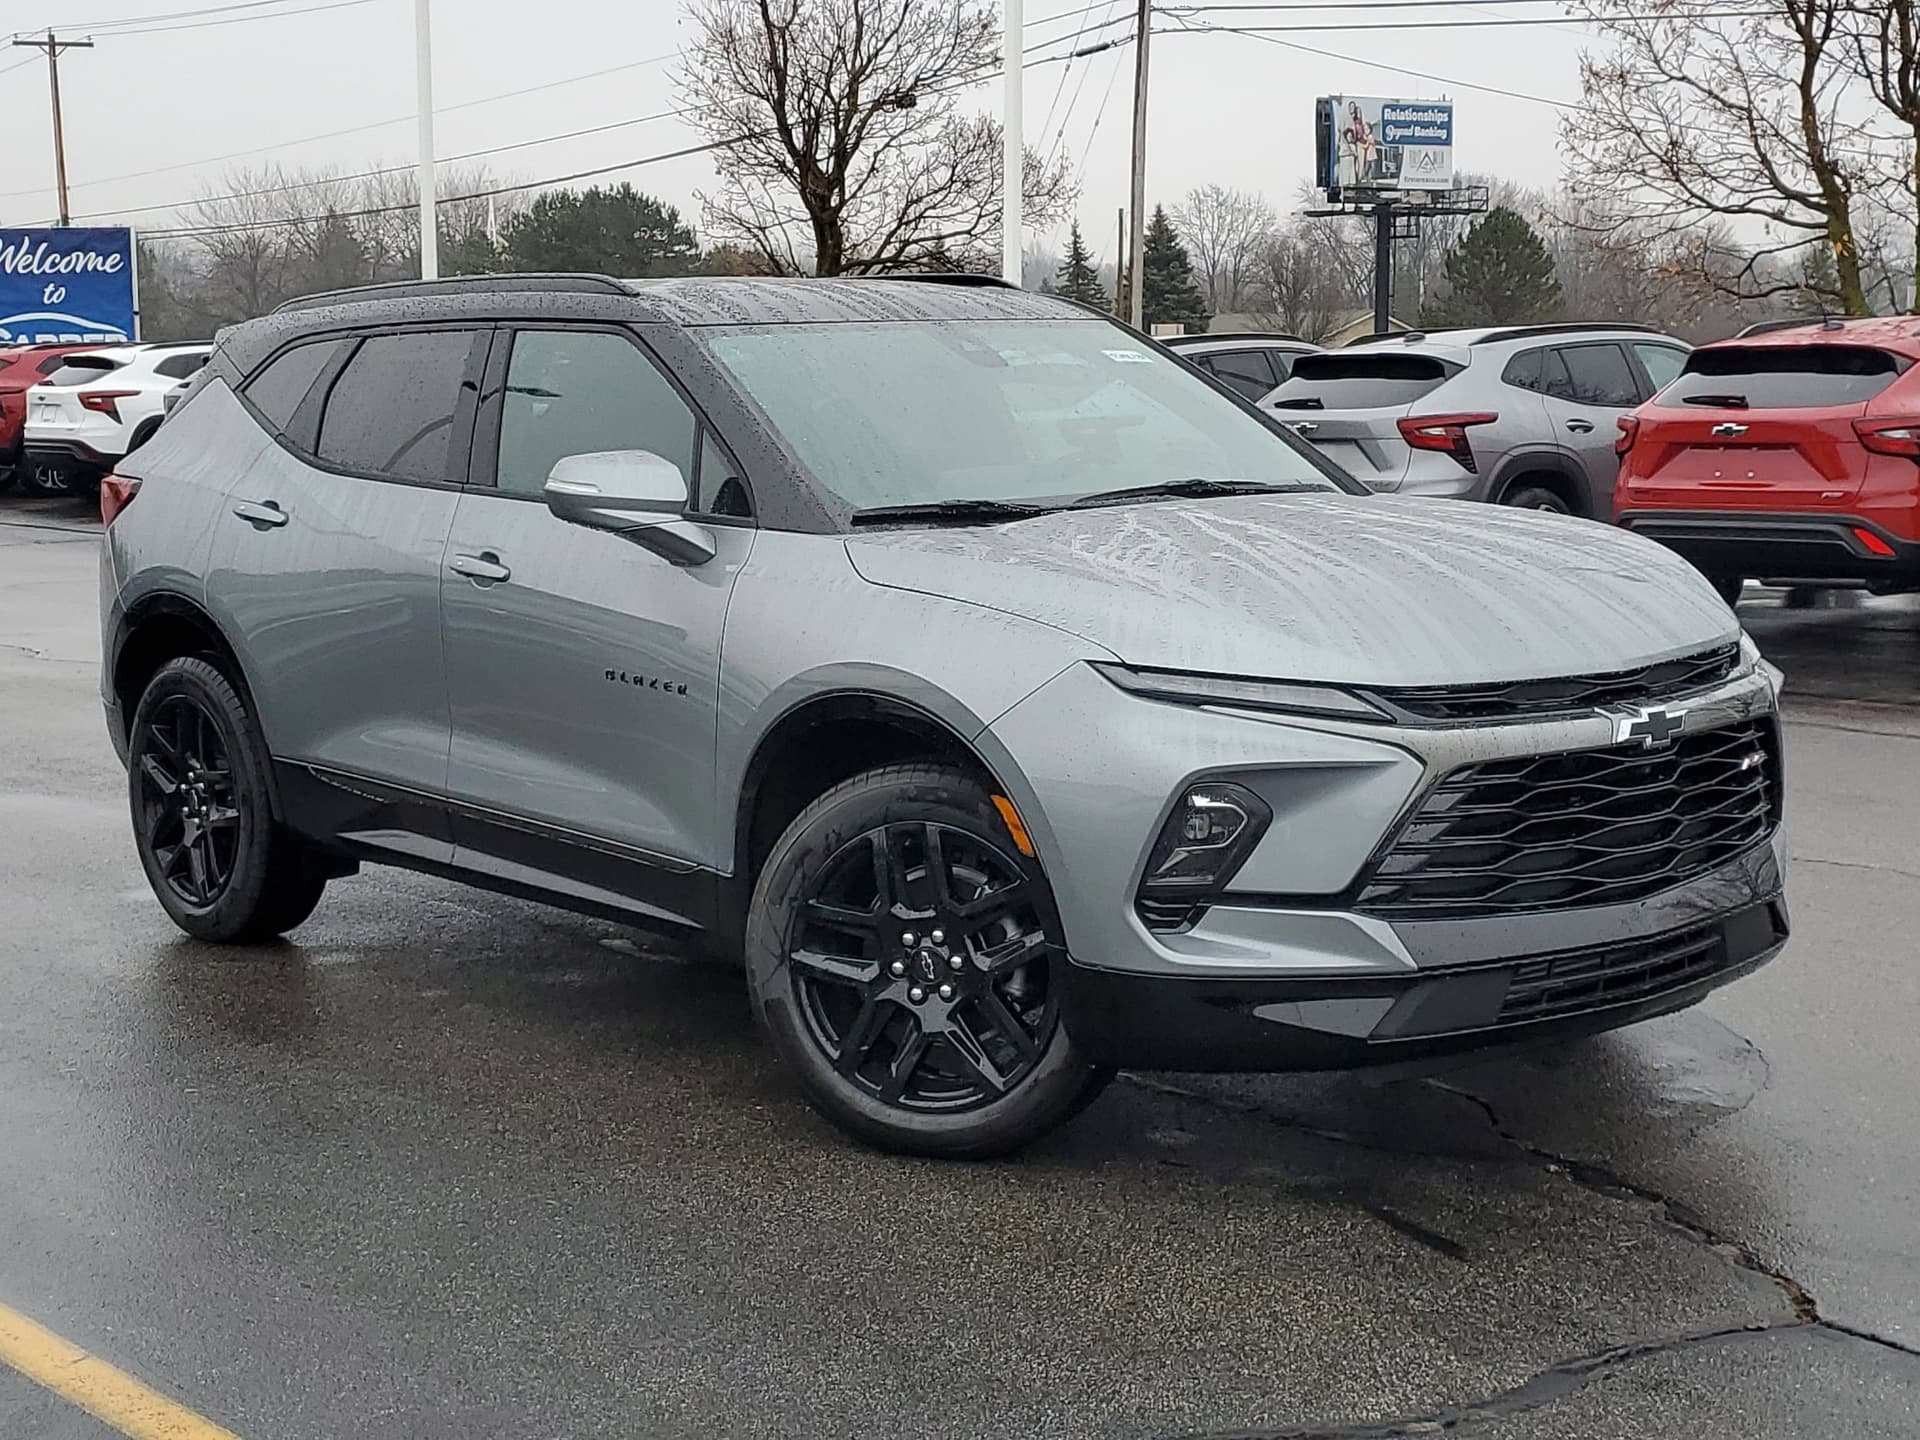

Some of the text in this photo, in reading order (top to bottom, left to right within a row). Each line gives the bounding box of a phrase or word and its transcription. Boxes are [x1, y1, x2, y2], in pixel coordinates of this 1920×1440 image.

[1384, 108, 1449, 125] Relationships
[0, 236, 124, 274] Welcome
[43, 283, 66, 304] to
[605, 670, 688, 695] BLAZER
